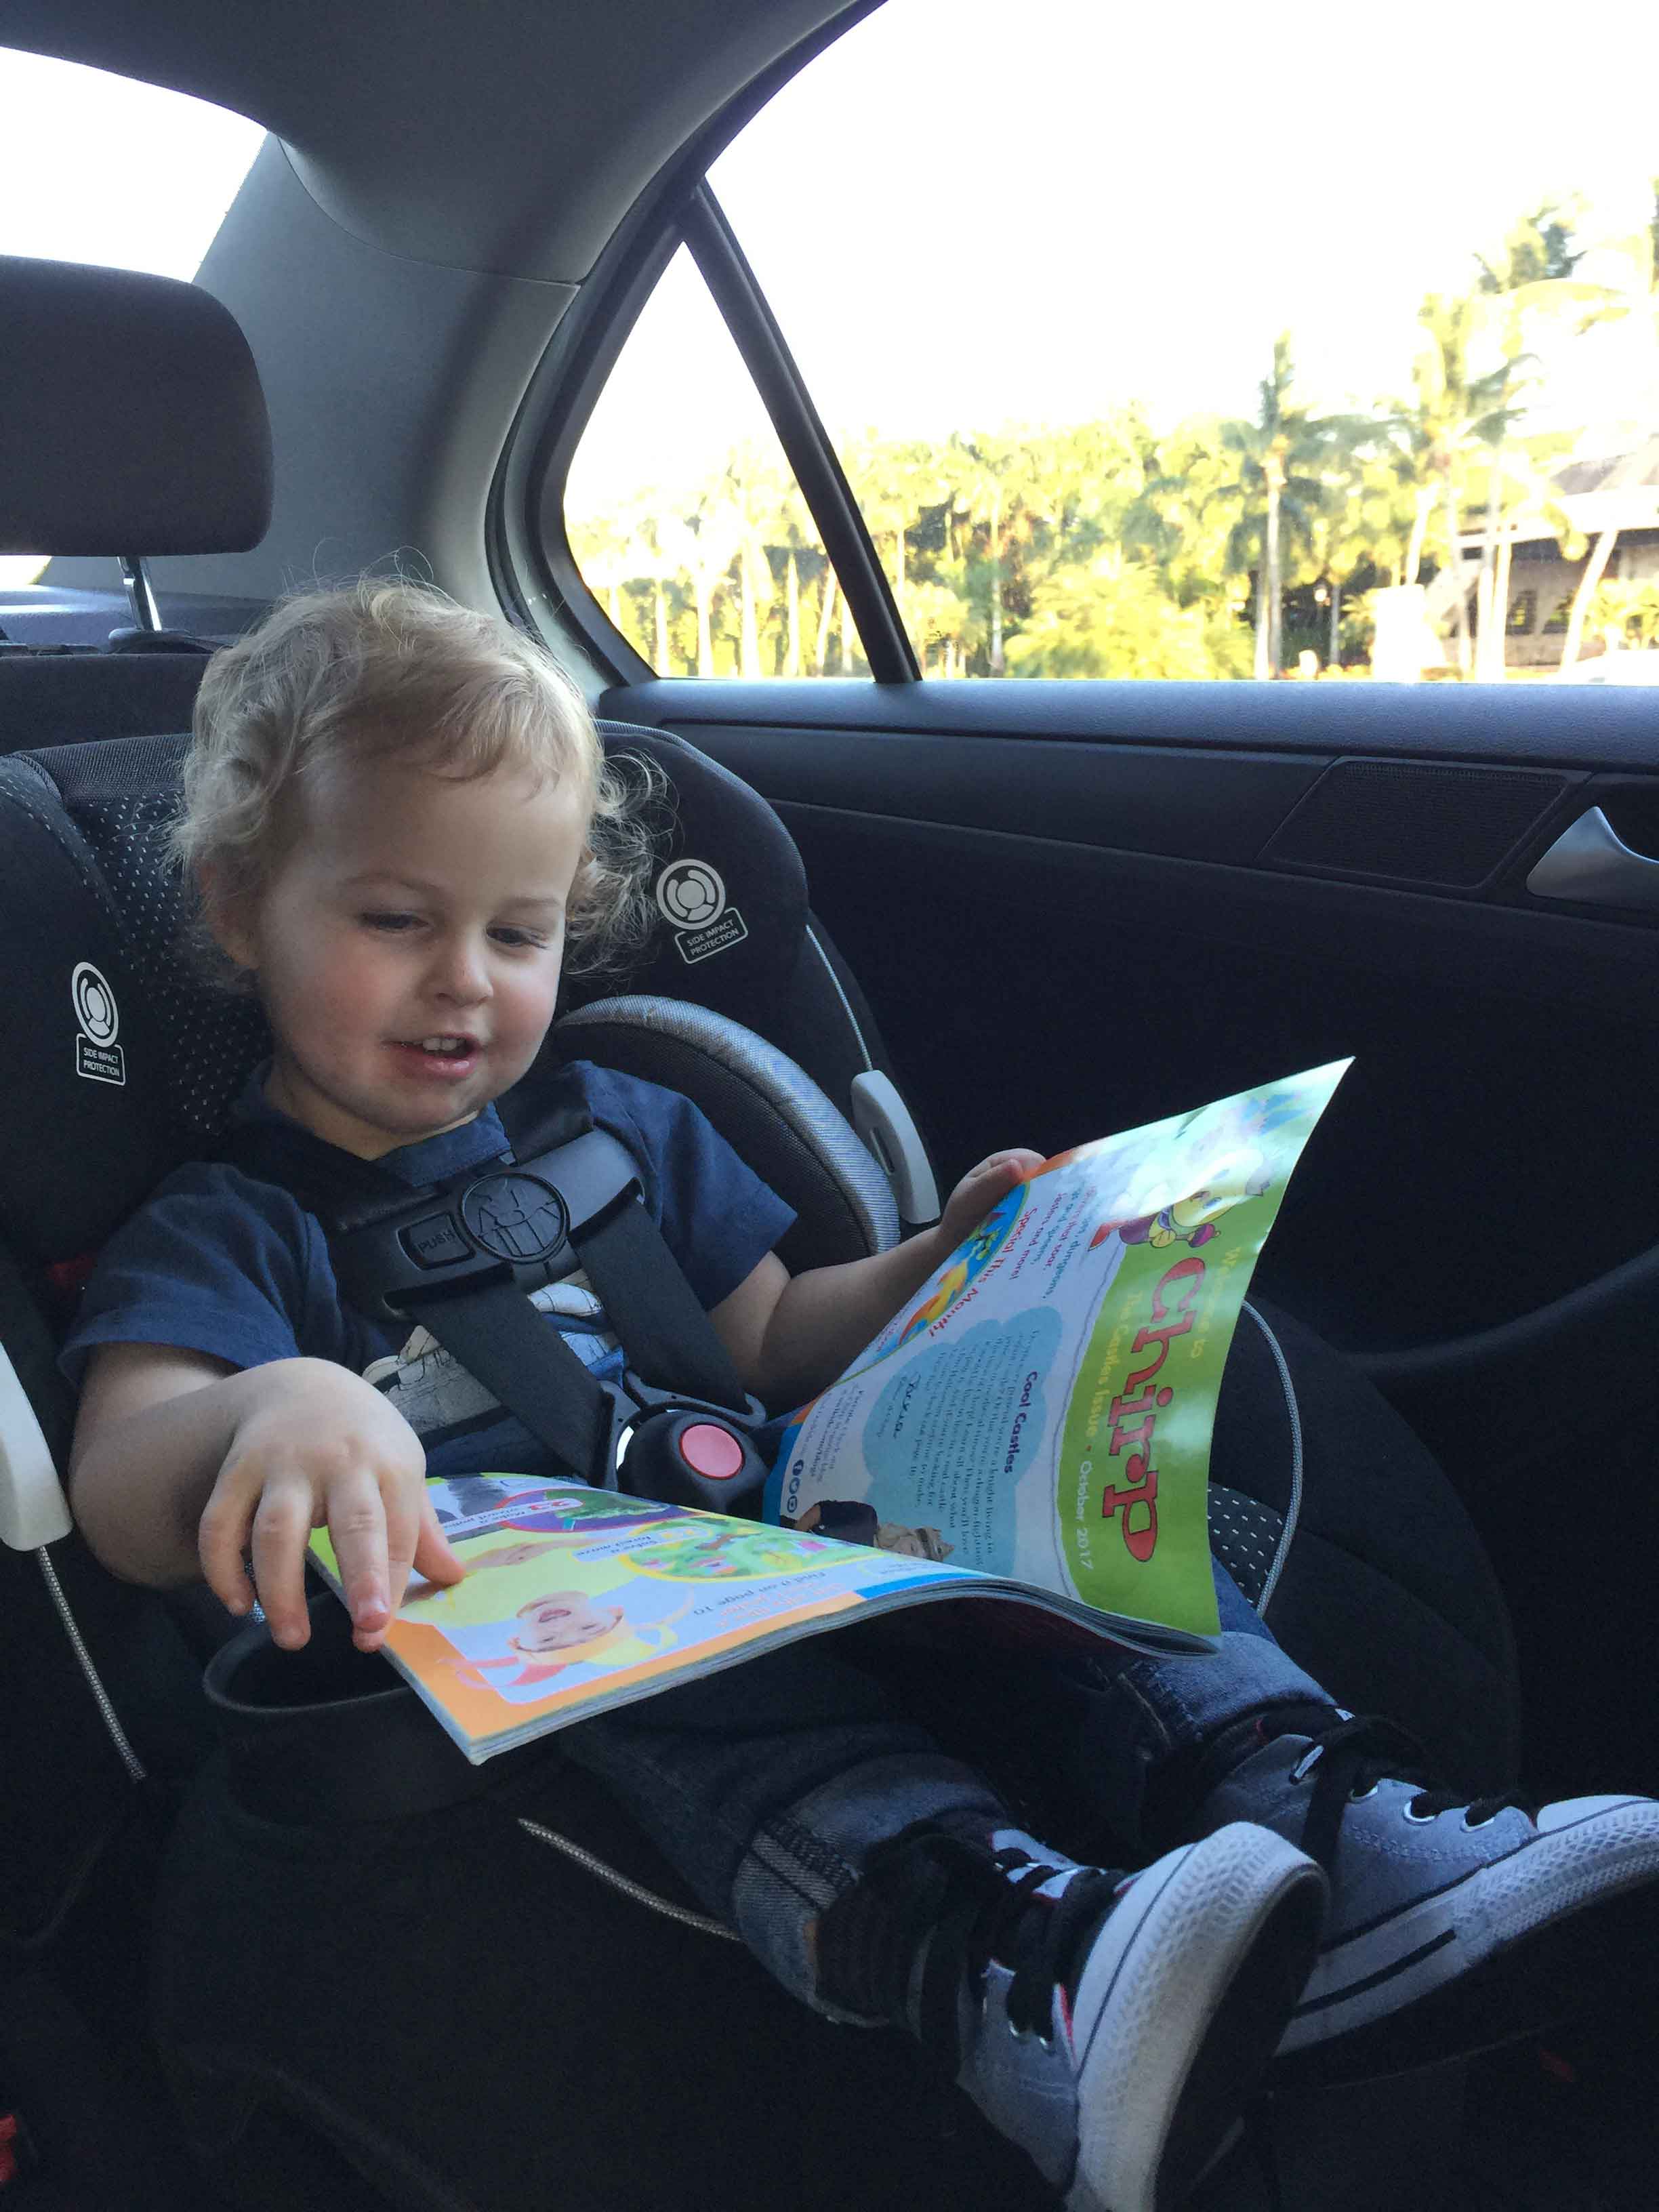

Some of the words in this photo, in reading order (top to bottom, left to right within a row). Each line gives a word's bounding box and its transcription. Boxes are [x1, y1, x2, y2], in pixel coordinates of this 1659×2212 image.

[687, 934, 705, 947] SIDE
[705, 920, 734, 939] IMPACT
[690, 929, 739, 956] PROTECTION
[83, 1047, 97, 1059] SIDE
[98, 1051, 118, 1063] IMPACT
[83, 1060, 119, 1076] PROTECTION
[417, 1229, 456, 1252] PUSH
[1002, 1207, 1038, 1253] Special
[1027, 1227, 1046, 1247] and
[978, 1256, 1007, 1284] This
[1008, 1249, 1031, 1281] more!
[1042, 1240, 1082, 1300] dungeons,
[928, 1288, 980, 1338] Month!
[1098, 1323, 1130, 1385] Castles
[1191, 1338, 1207, 1359] to
[1019, 1371, 1039, 1408] Cool
[1086, 1389, 1111, 1437] Issue
[1102, 1257, 1205, 1563] Chirp
[1004, 1412, 1027, 1474] Castles
[986, 1468, 999, 1503] knight
[1076, 1460, 1094, 1522] October
[985, 1507, 995, 1540] living
[1076, 1528, 1094, 1570] 2017
[716, 1588, 754, 1606] page
[758, 1583, 777, 1593] on
[693, 1604, 714, 1616] 10
